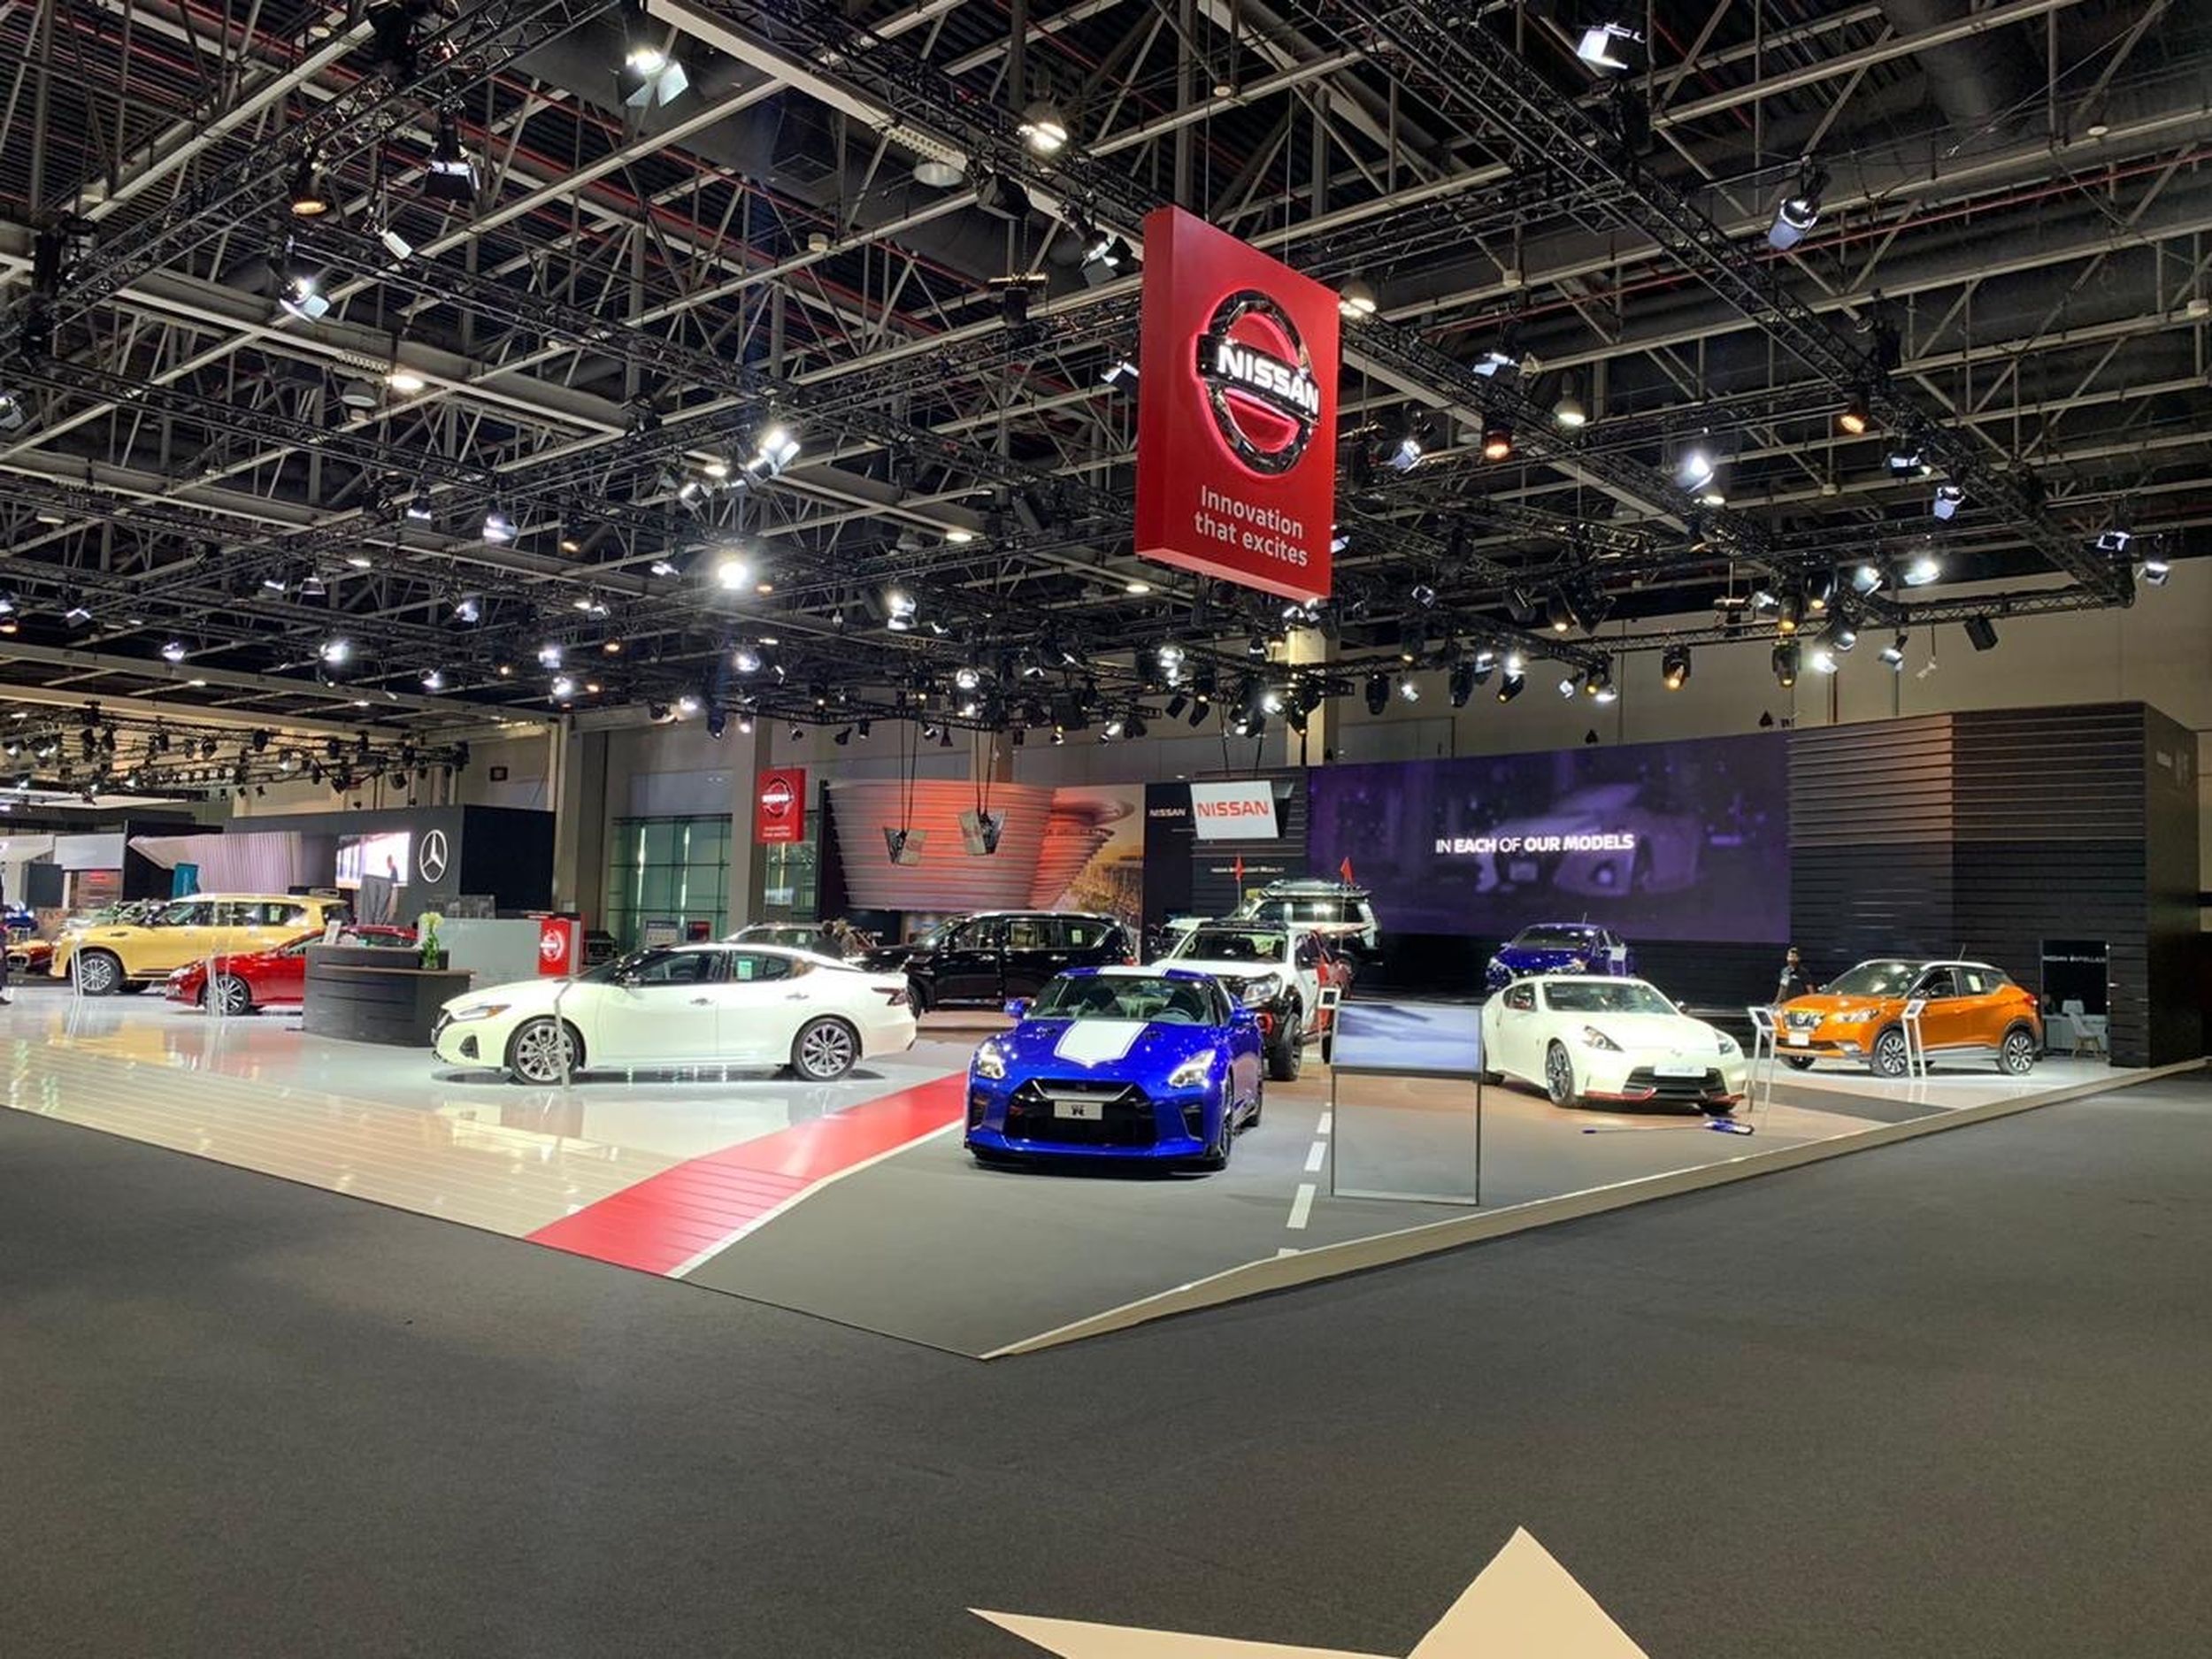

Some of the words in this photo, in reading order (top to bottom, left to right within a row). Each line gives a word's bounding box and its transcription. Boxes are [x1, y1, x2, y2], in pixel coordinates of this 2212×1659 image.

[1217, 345, 1318, 415] NISSAN
[1194, 511, 1236, 543] that
[1242, 532, 1308, 567] excites
[1201, 485, 1303, 539] Innovation
[1197, 801, 1270, 817] NISSAN
[1436, 839, 1451, 853] IN
[1454, 838, 1496, 853] EACH
[1499, 837, 1521, 852] OF
[1524, 836, 1561, 852] OUR
[1563, 833, 1635, 850] MODELS
